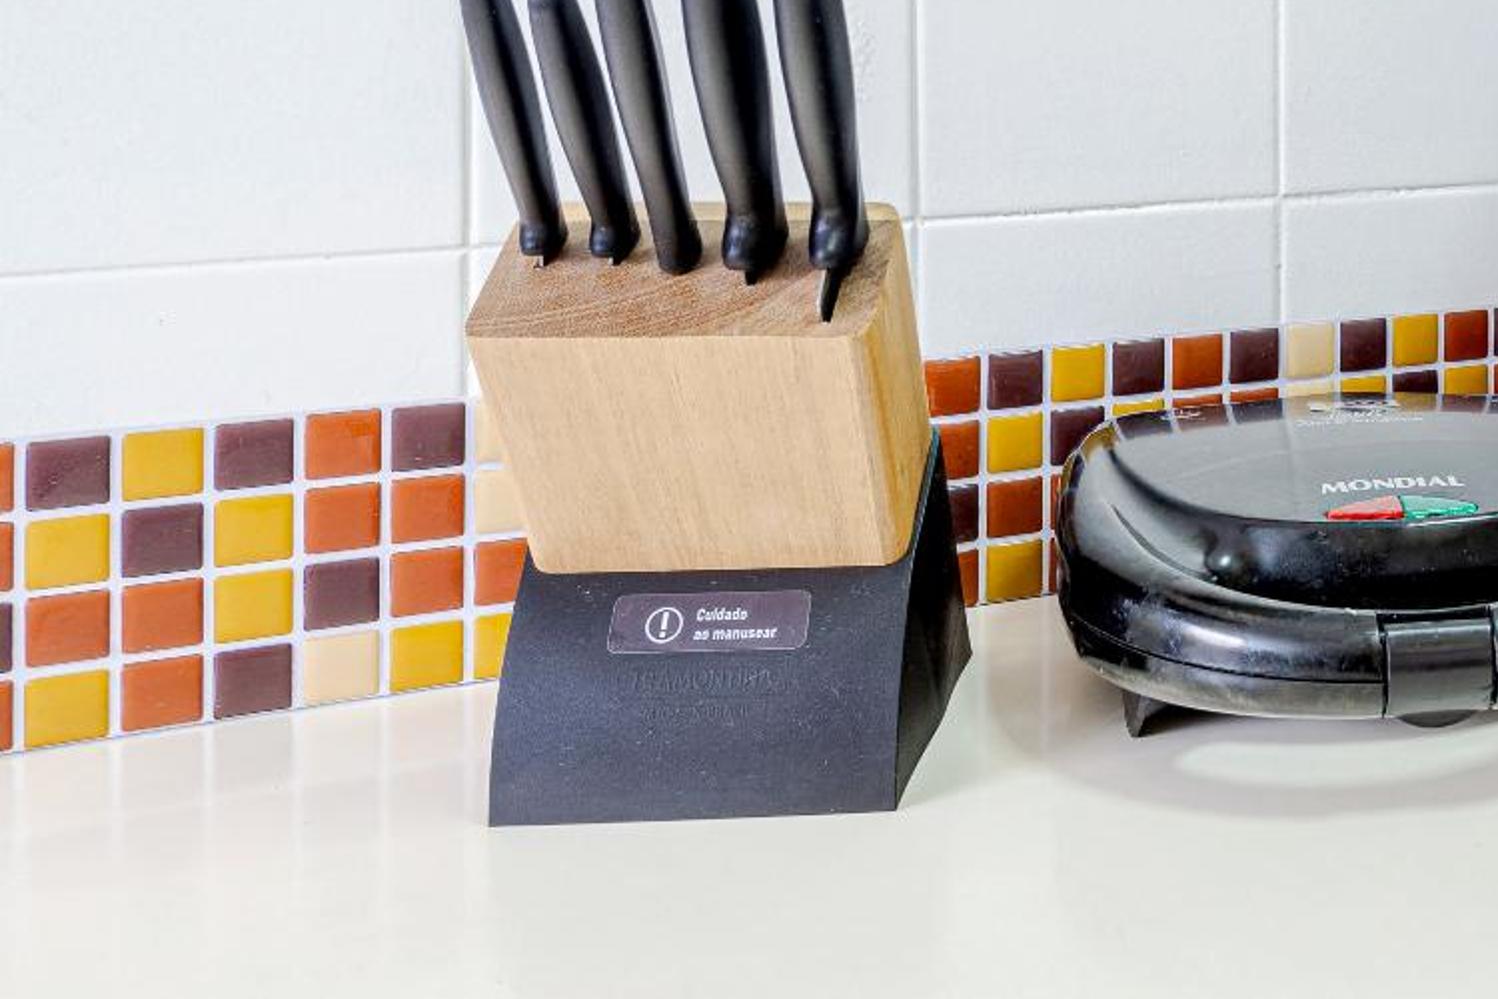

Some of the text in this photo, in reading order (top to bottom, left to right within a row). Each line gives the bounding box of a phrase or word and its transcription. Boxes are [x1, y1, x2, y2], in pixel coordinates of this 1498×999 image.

[1321, 475, 1467, 495] MONDIAL
[696, 607, 749, 622] Cuidado
[693, 627, 778, 641] ao manusear
